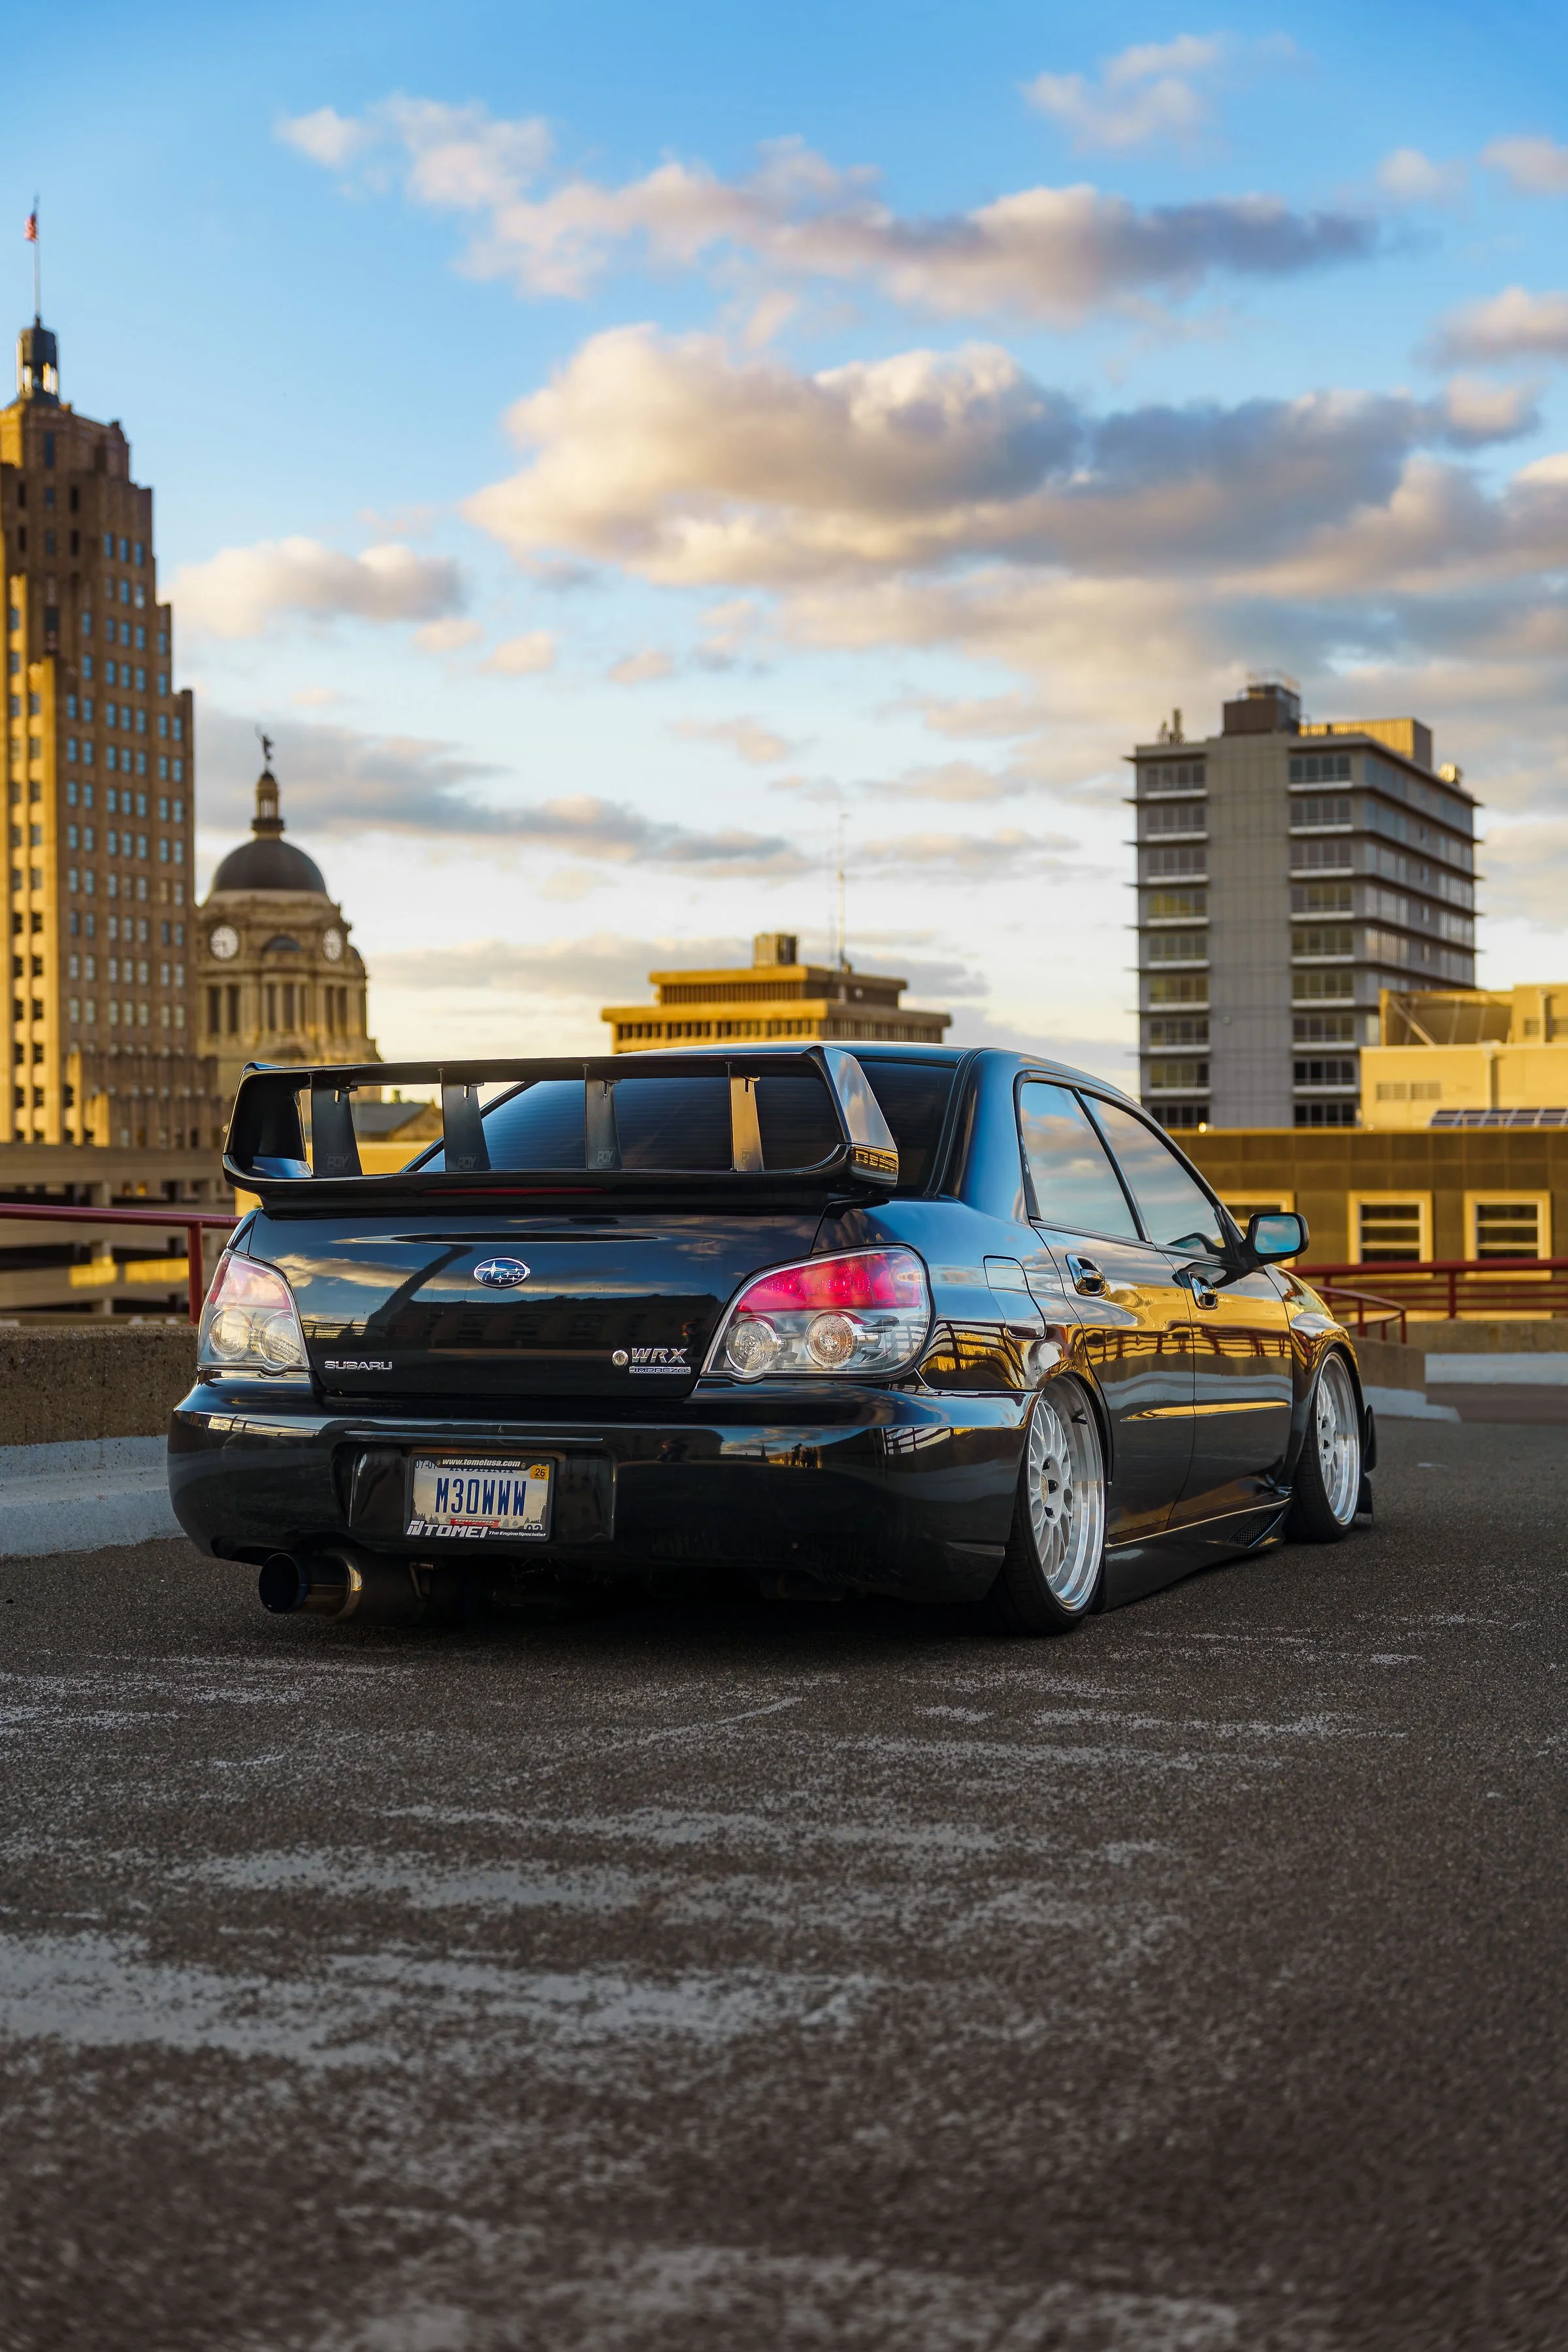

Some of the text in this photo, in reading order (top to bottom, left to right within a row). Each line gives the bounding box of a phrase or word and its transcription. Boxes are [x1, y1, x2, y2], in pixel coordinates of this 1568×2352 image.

[631, 1347, 689, 1364] WRX
[324, 1360, 393, 1370] SUBARU
[442, 1458, 521, 1467] www.tomeiusa.com
[534, 1468, 546, 1477] 26
[424, 1524, 489, 1538] TOMEI
